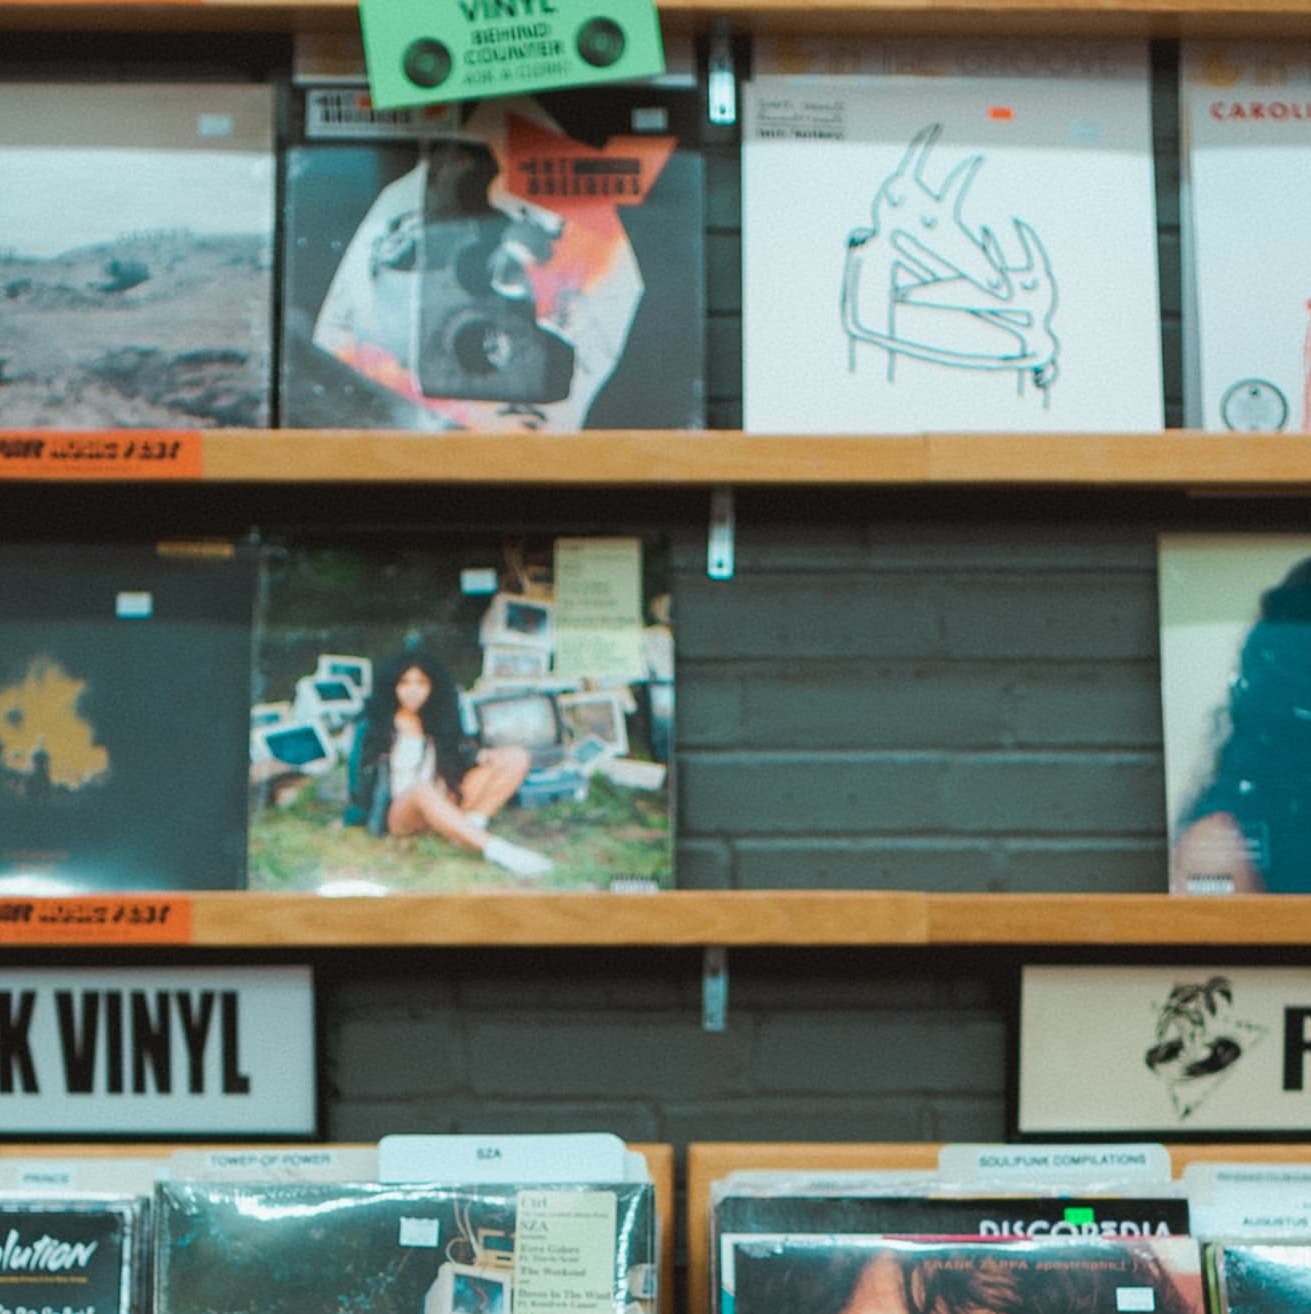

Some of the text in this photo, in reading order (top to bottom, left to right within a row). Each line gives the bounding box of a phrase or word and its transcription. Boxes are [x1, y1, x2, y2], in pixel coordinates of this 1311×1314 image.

[458, 0, 559, 22] VINYL
[472, 24, 551, 45] BEHIND
[464, 41, 564, 65] COUNTER
[54, 988, 251, 1095] VINYL
[476, 1147, 502, 1160] SZA
[1053, 1153, 1146, 1166] COMPILATIONS
[22, 1173, 69, 1184] PRINCE
[1242, 1216, 1308, 1228] AUGUSTUS
